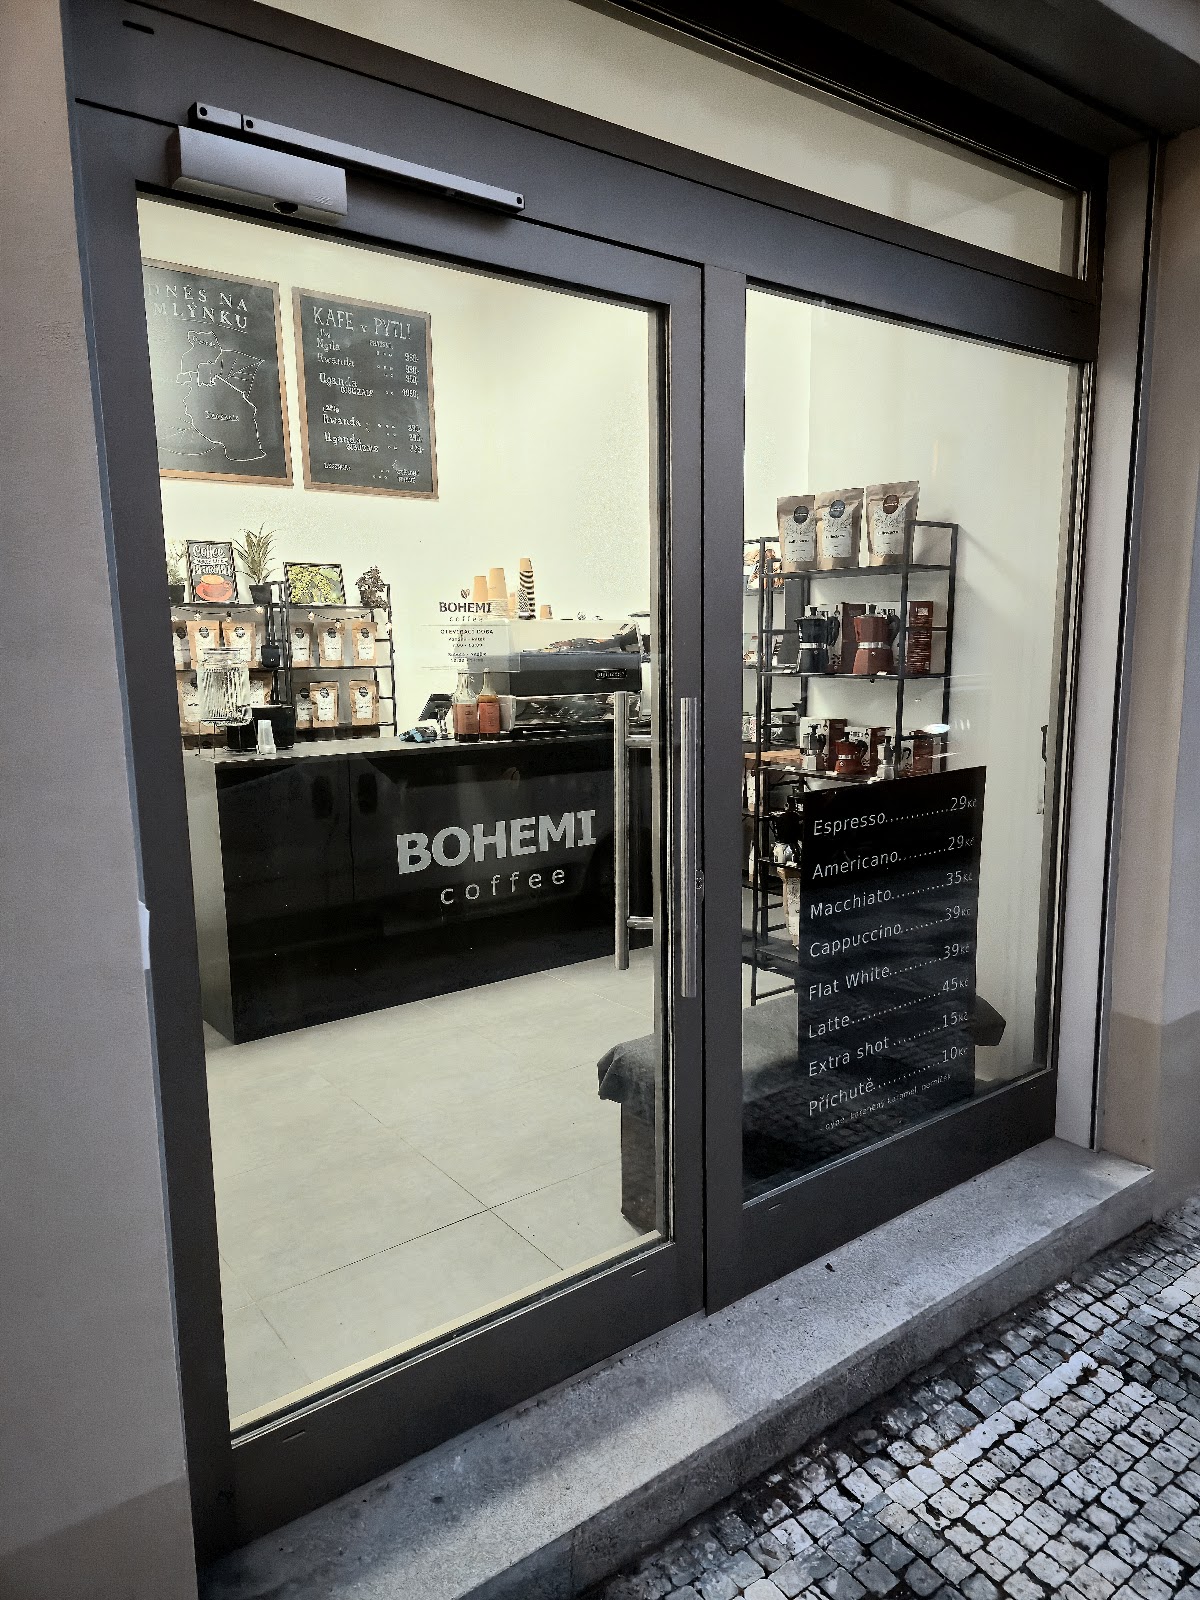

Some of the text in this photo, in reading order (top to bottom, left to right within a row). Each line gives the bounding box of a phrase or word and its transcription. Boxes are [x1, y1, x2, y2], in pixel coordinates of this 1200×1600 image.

[147, 282, 248, 312] DNES NA
[312, 305, 354, 332] KAFE
[438, 601, 492, 614] BOHEMI
[813, 811, 886, 837] Espresso
[396, 809, 597, 875] BOHEMI
[812, 850, 899, 880] Americano
[440, 869, 565, 905] coffee
[810, 888, 892, 919] Macchiato
[809, 922, 902, 958] Cappuccino
[809, 979, 840, 1001] Flat
[845, 966, 890, 989] White
[808, 1014, 851, 1039] Latte
[809, 1052, 850, 1077] Extra
[856, 1036, 890, 1059] shot
